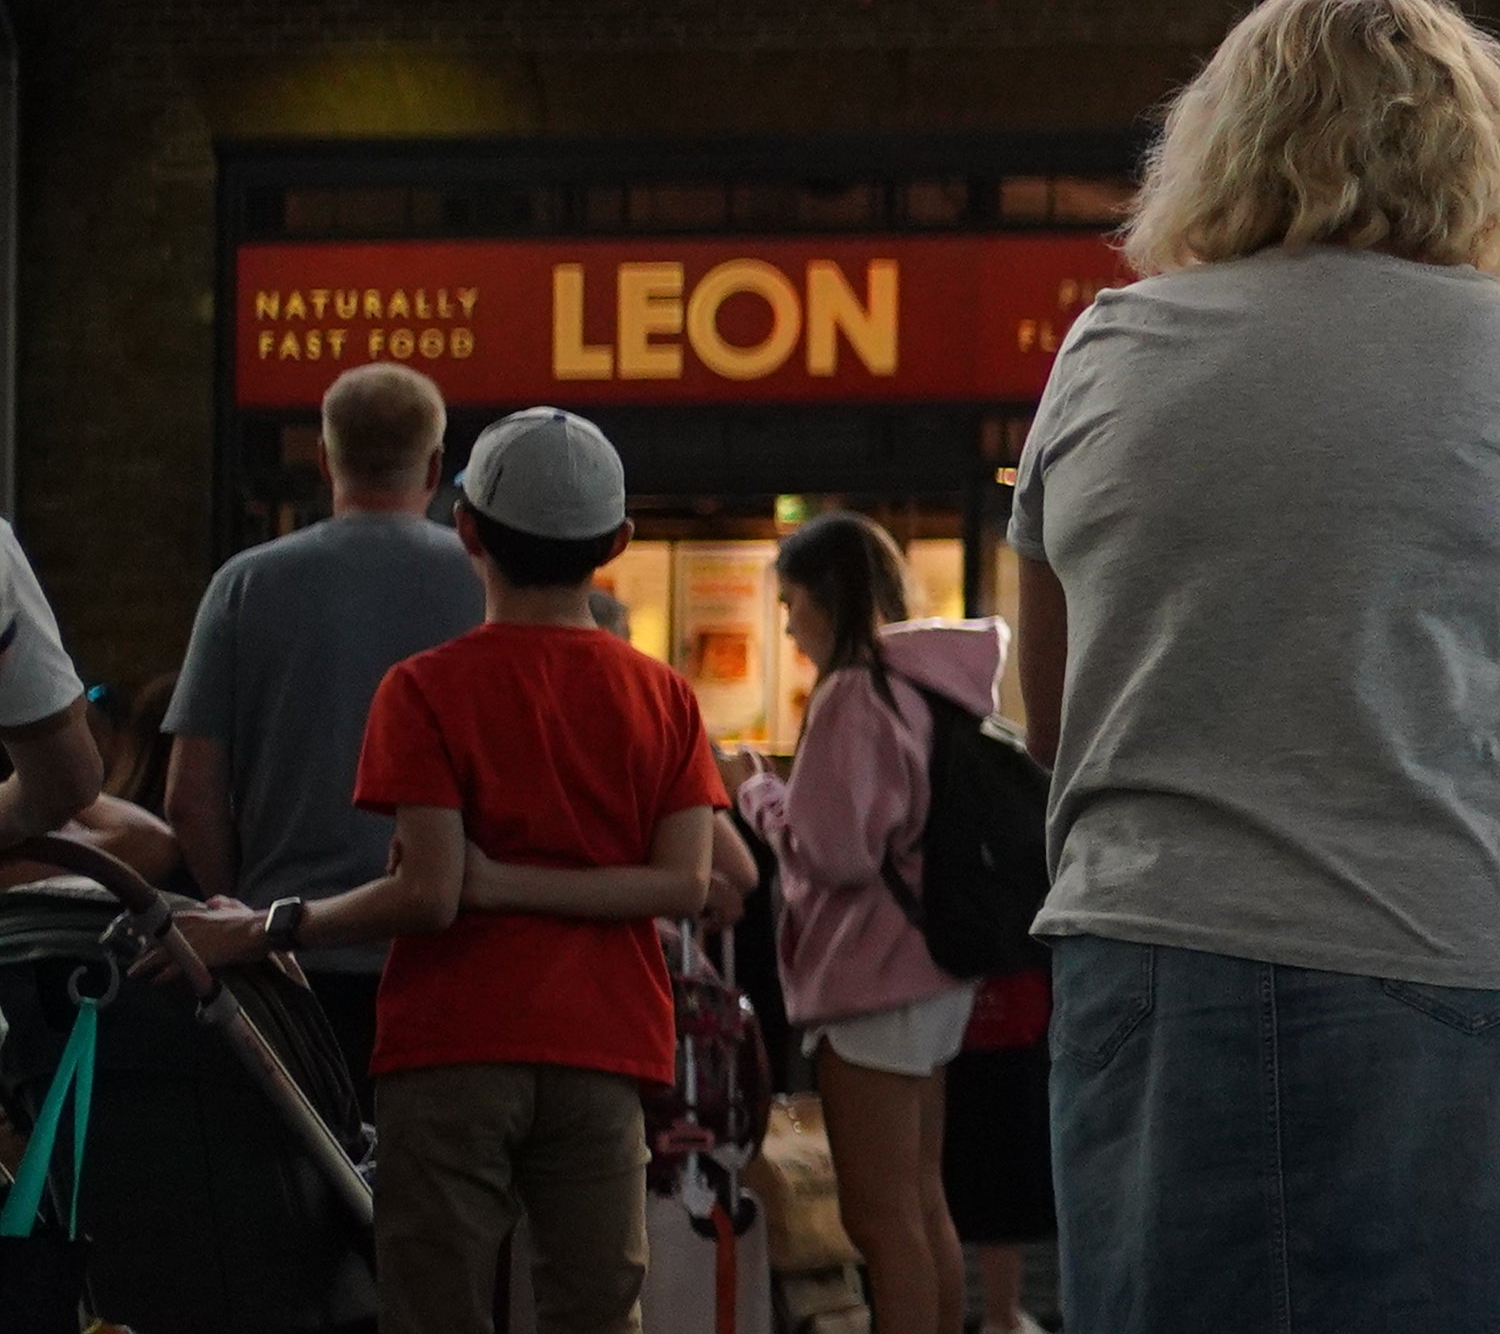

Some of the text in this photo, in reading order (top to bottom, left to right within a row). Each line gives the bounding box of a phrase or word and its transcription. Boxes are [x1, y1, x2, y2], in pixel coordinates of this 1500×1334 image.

[255, 287, 480, 321] NATURALLY
[552, 258, 899, 380] LEON
[258, 327, 475, 361] FAST FOOD
